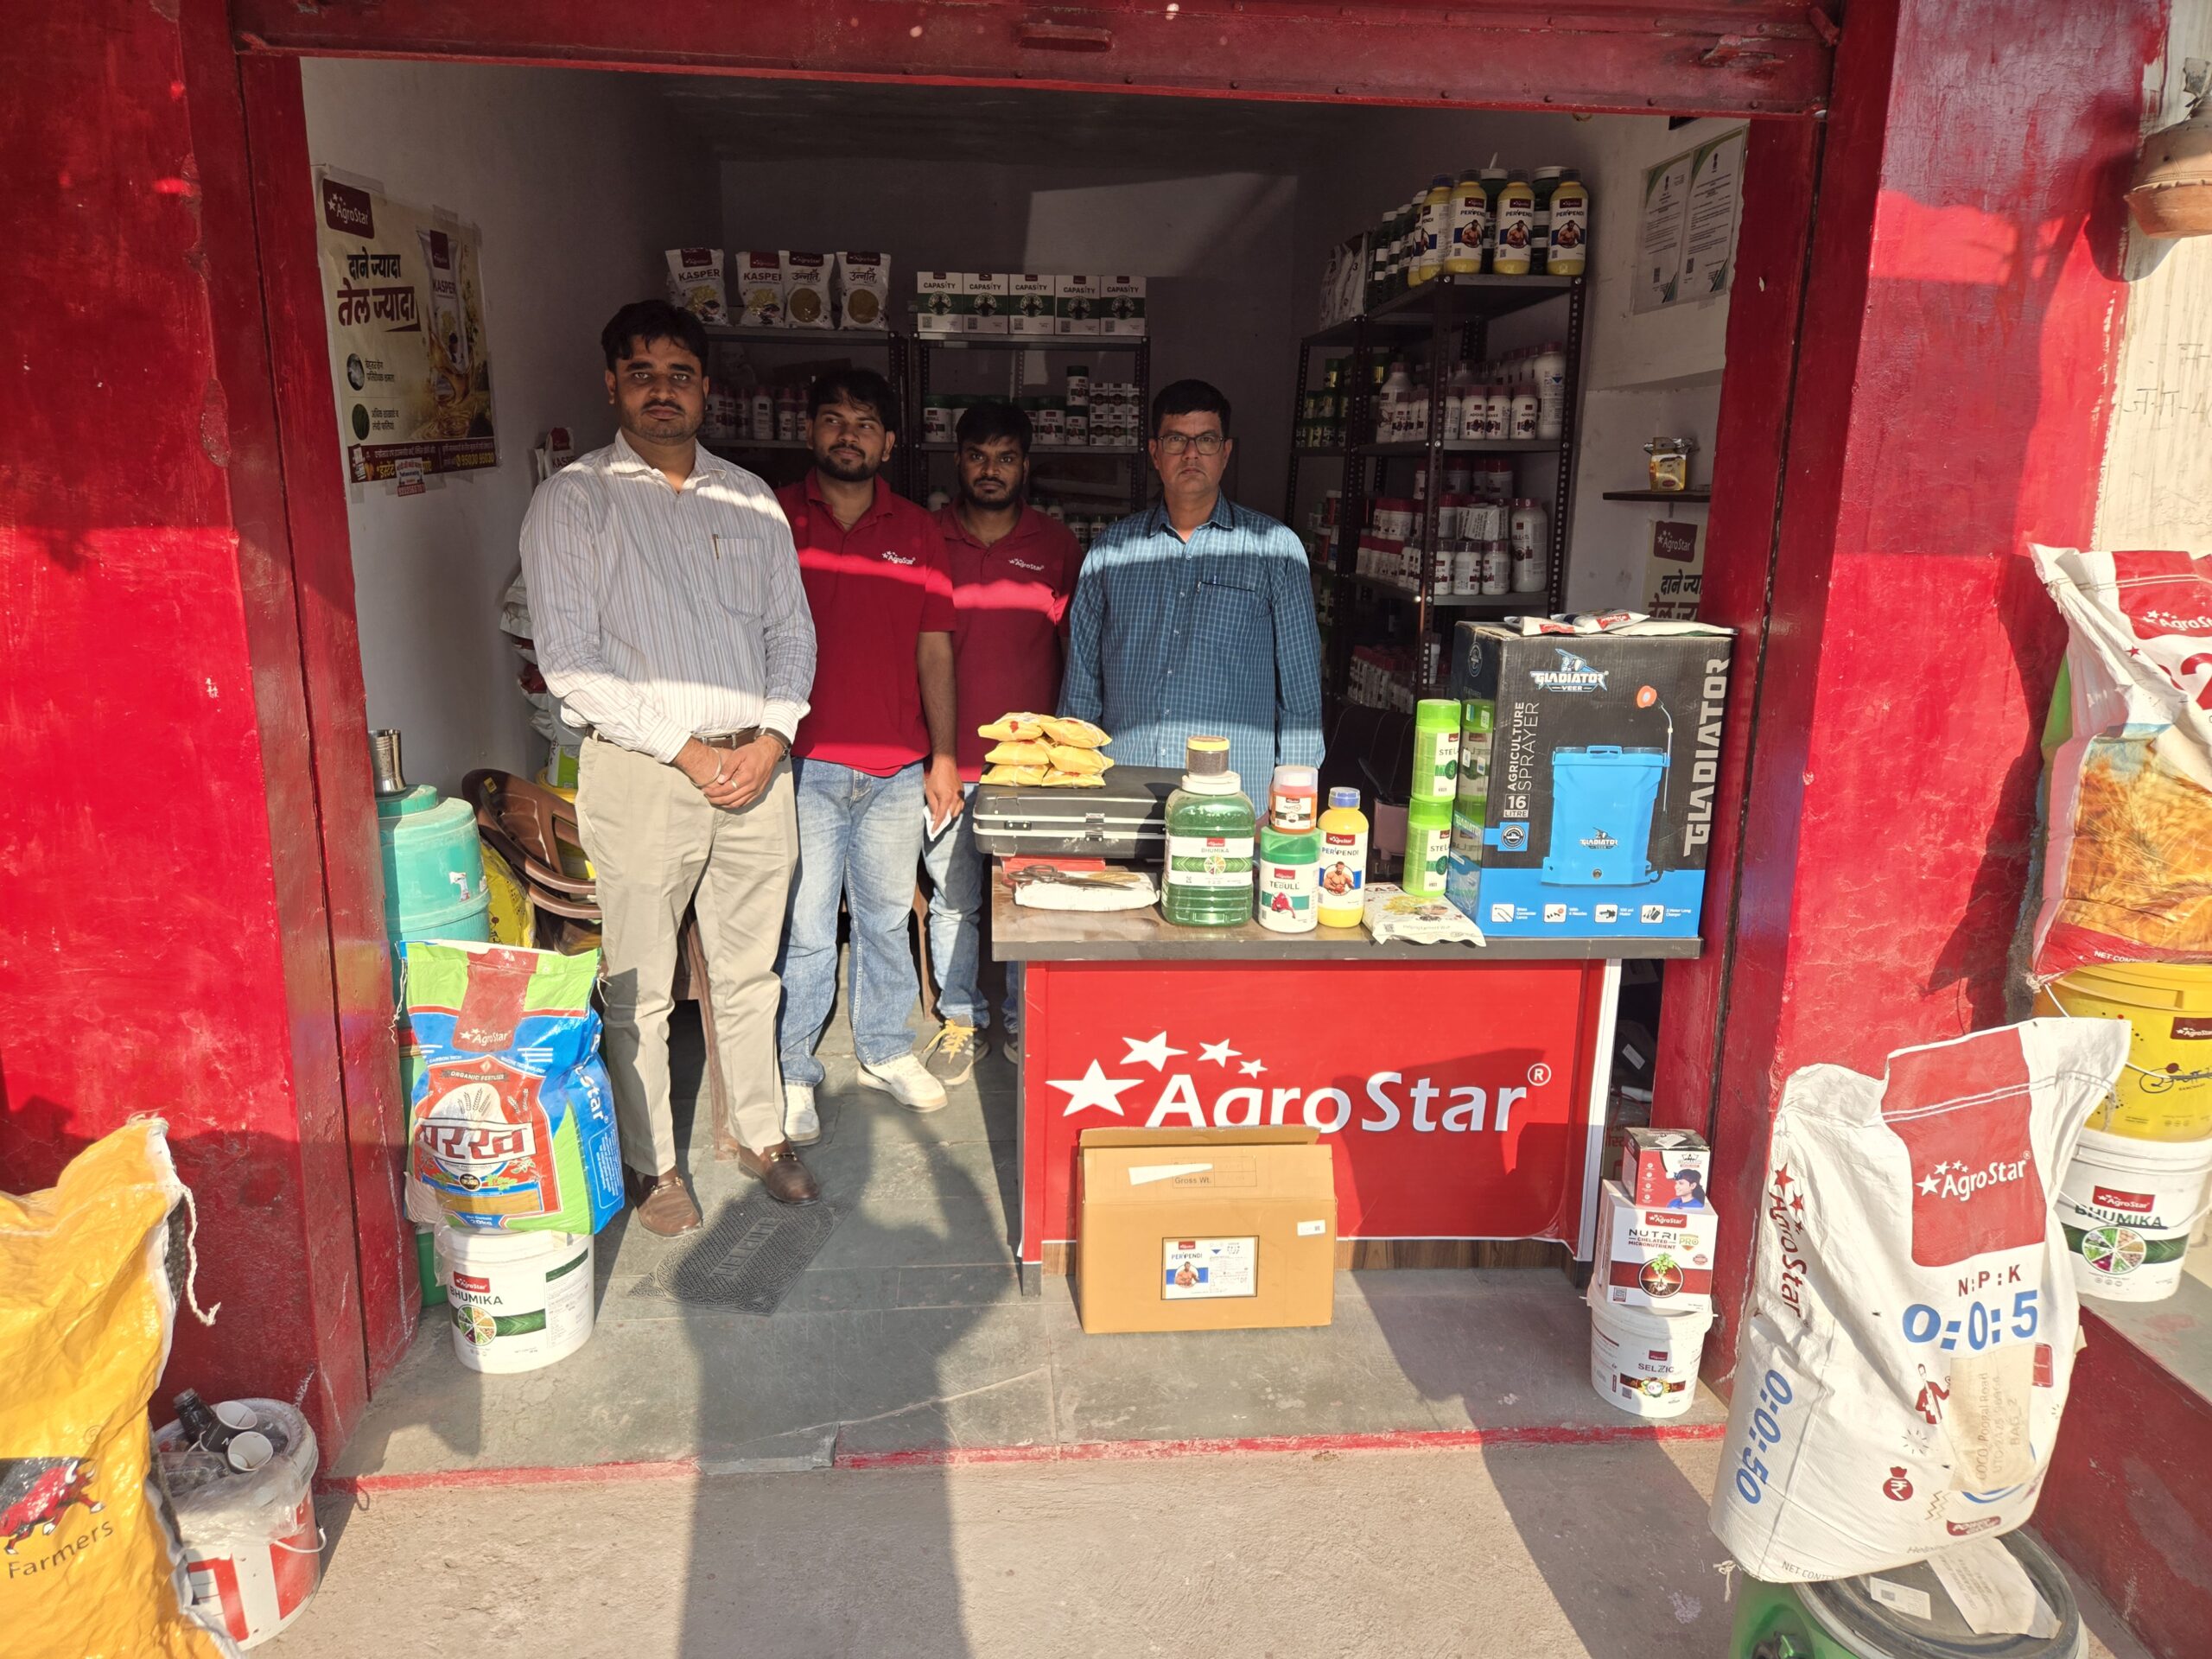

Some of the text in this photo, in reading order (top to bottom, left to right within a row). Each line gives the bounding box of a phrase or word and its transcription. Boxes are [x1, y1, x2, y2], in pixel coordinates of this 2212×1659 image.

[336, 203, 369, 226] AgroStar
[347, 246, 401, 280] दाने ज्यादा
[678, 269, 721, 282] KASPER
[337, 277, 415, 326] तेल ज्यादा
[1662, 536, 1691, 553] AgroStar
[887, 554, 914, 565] AgroStar
[1661, 569, 1682, 594] दाने
[1530, 671, 1605, 685] GLADIATOR
[1508, 702, 1525, 791] AGRICULTURE
[1518, 702, 1540, 791] SPRAYER
[1683, 658, 1730, 857] GLADIATOR
[1509, 796, 1527, 809] 16
[2094, 950, 2113, 961] NET
[473, 1031, 508, 1047] AgroStar
[450, 1071, 480, 1081] ORGANIC
[2107, 1198, 2150, 1209] AgroStar
[1655, 1216, 1683, 1224] AgroStar
[1629, 1229, 1676, 1241] NUTRI
[1629, 1241, 1676, 1249] MICRONUTRIENT
[449, 1285, 503, 1306] BHUMIKA
[1638, 1363, 1675, 1373] SELZIC
[1979, 1373, 1989, 1402] Road
[1736, 1369, 1793, 1504] 0:0:50
[9, 1520, 113, 1579] Farmers
[1782, 1560, 1801, 1576] NET
